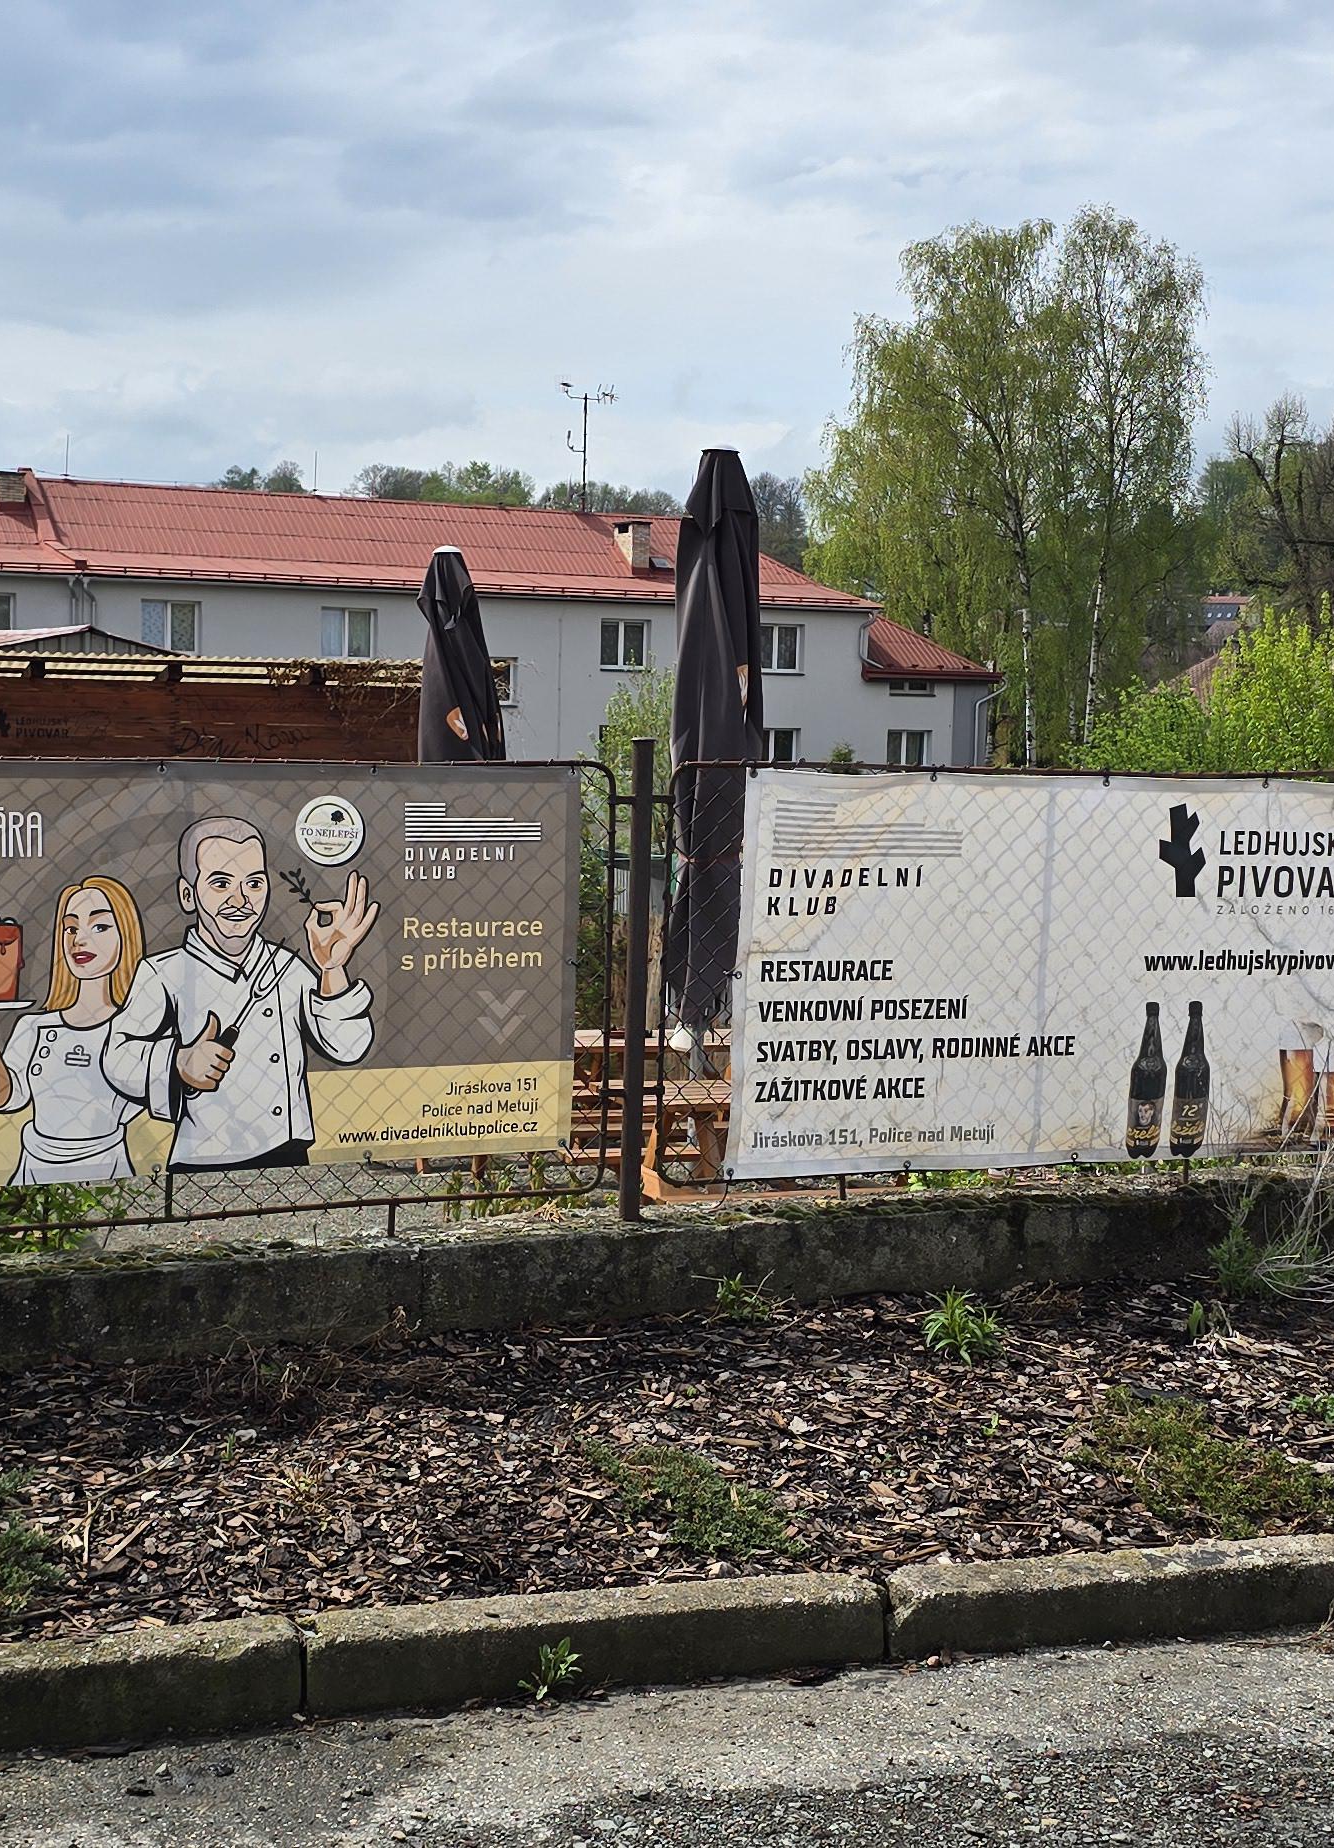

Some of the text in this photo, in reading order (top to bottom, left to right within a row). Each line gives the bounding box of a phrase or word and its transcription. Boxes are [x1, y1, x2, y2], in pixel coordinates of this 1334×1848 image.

[15, 728, 69, 738] PIVOVAR
[300, 827, 359, 839] TO NEJLEPŠÍ
[405, 844, 515, 862] DIVADELNÍ
[405, 865, 457, 880] KLUB
[768, 864, 924, 889] DIVADELNÍ
[767, 896, 837, 916] KLUB
[1217, 902, 1310, 915] ZALOŽENO
[403, 917, 544, 939] Restaurace
[400, 947, 543, 976] s příběhem
[760, 959, 894, 982] RESTAURACE
[758, 994, 969, 1023] VENKOVNÍ POSEZENÍ
[756, 1032, 1076, 1065] SVATBY, OSLAVY, RODINNÉ AKCE
[446, 1077, 538, 1096] Jiráskova 151
[755, 1074, 925, 1102] ZÁŽITKOVÉ AKCE
[422, 1098, 539, 1118] Police nad Metují
[338, 1119, 539, 1144] www.divadelniklubpolice.cz
[751, 1123, 995, 1149] Jiráskova 151, Police nad Metují
